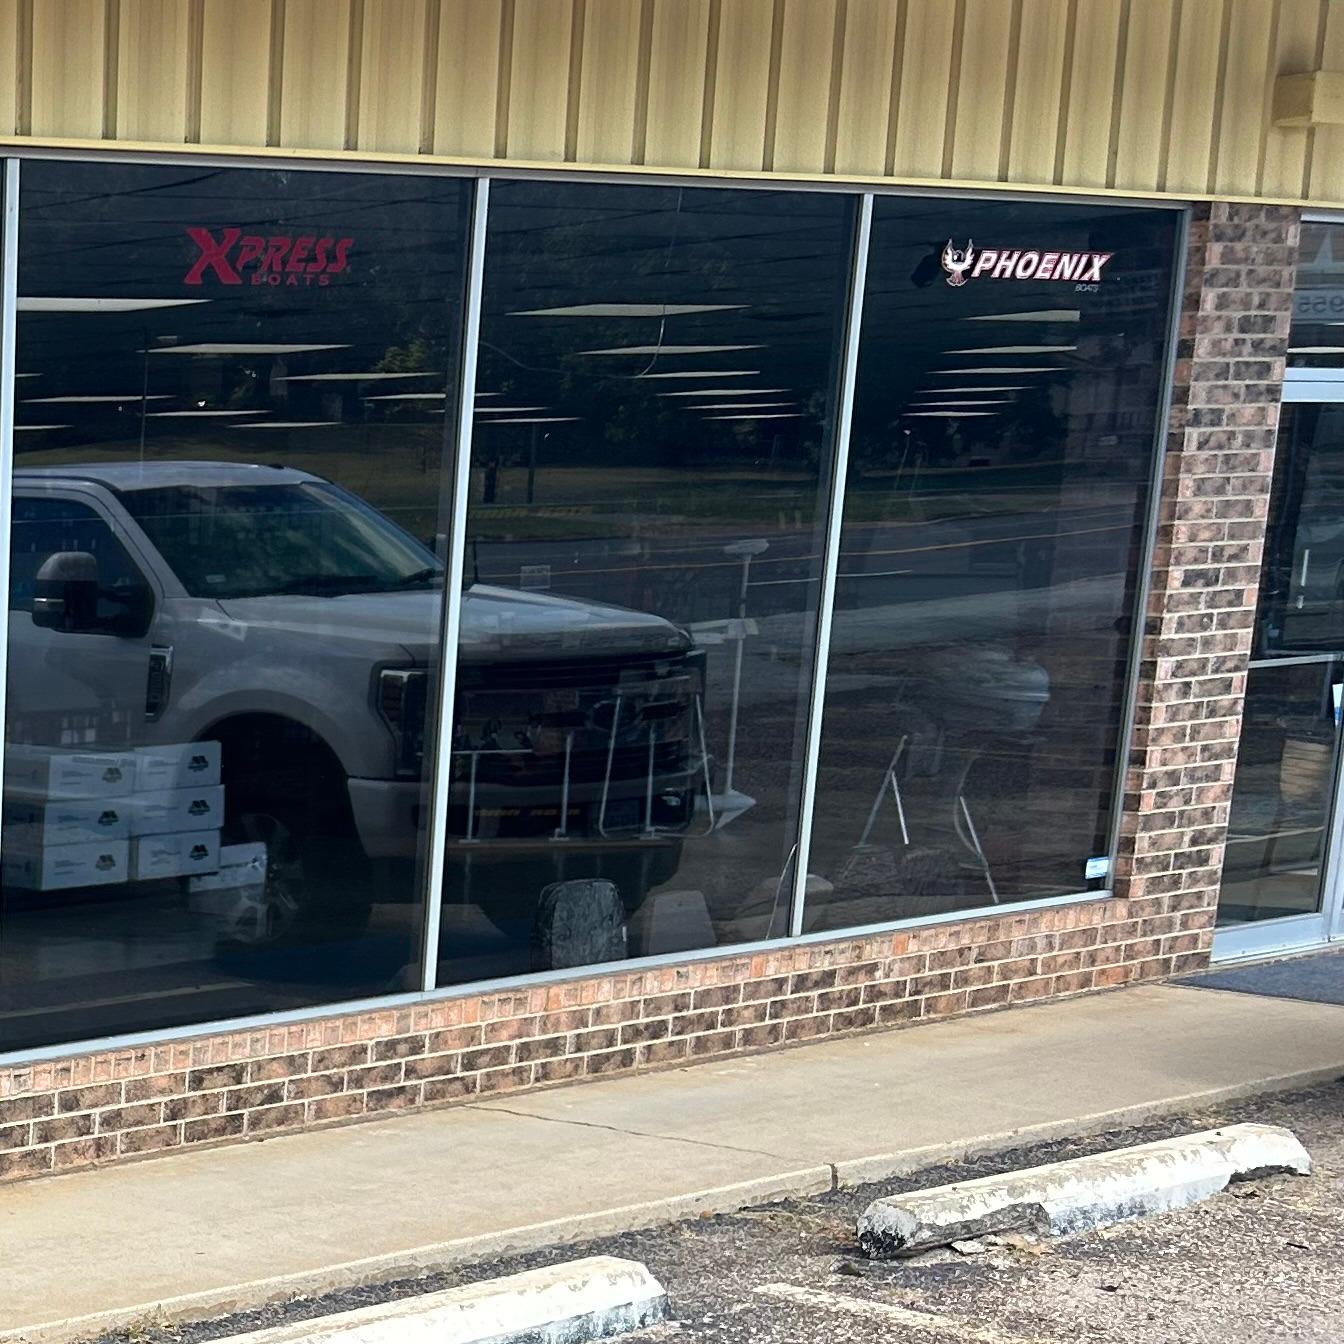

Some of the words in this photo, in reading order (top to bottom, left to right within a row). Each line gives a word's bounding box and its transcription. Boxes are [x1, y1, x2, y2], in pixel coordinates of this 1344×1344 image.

[183, 227, 354, 286] XPRESS
[970, 250, 1113, 282] PHOENIX
[250, 273, 331, 287] BOATS
